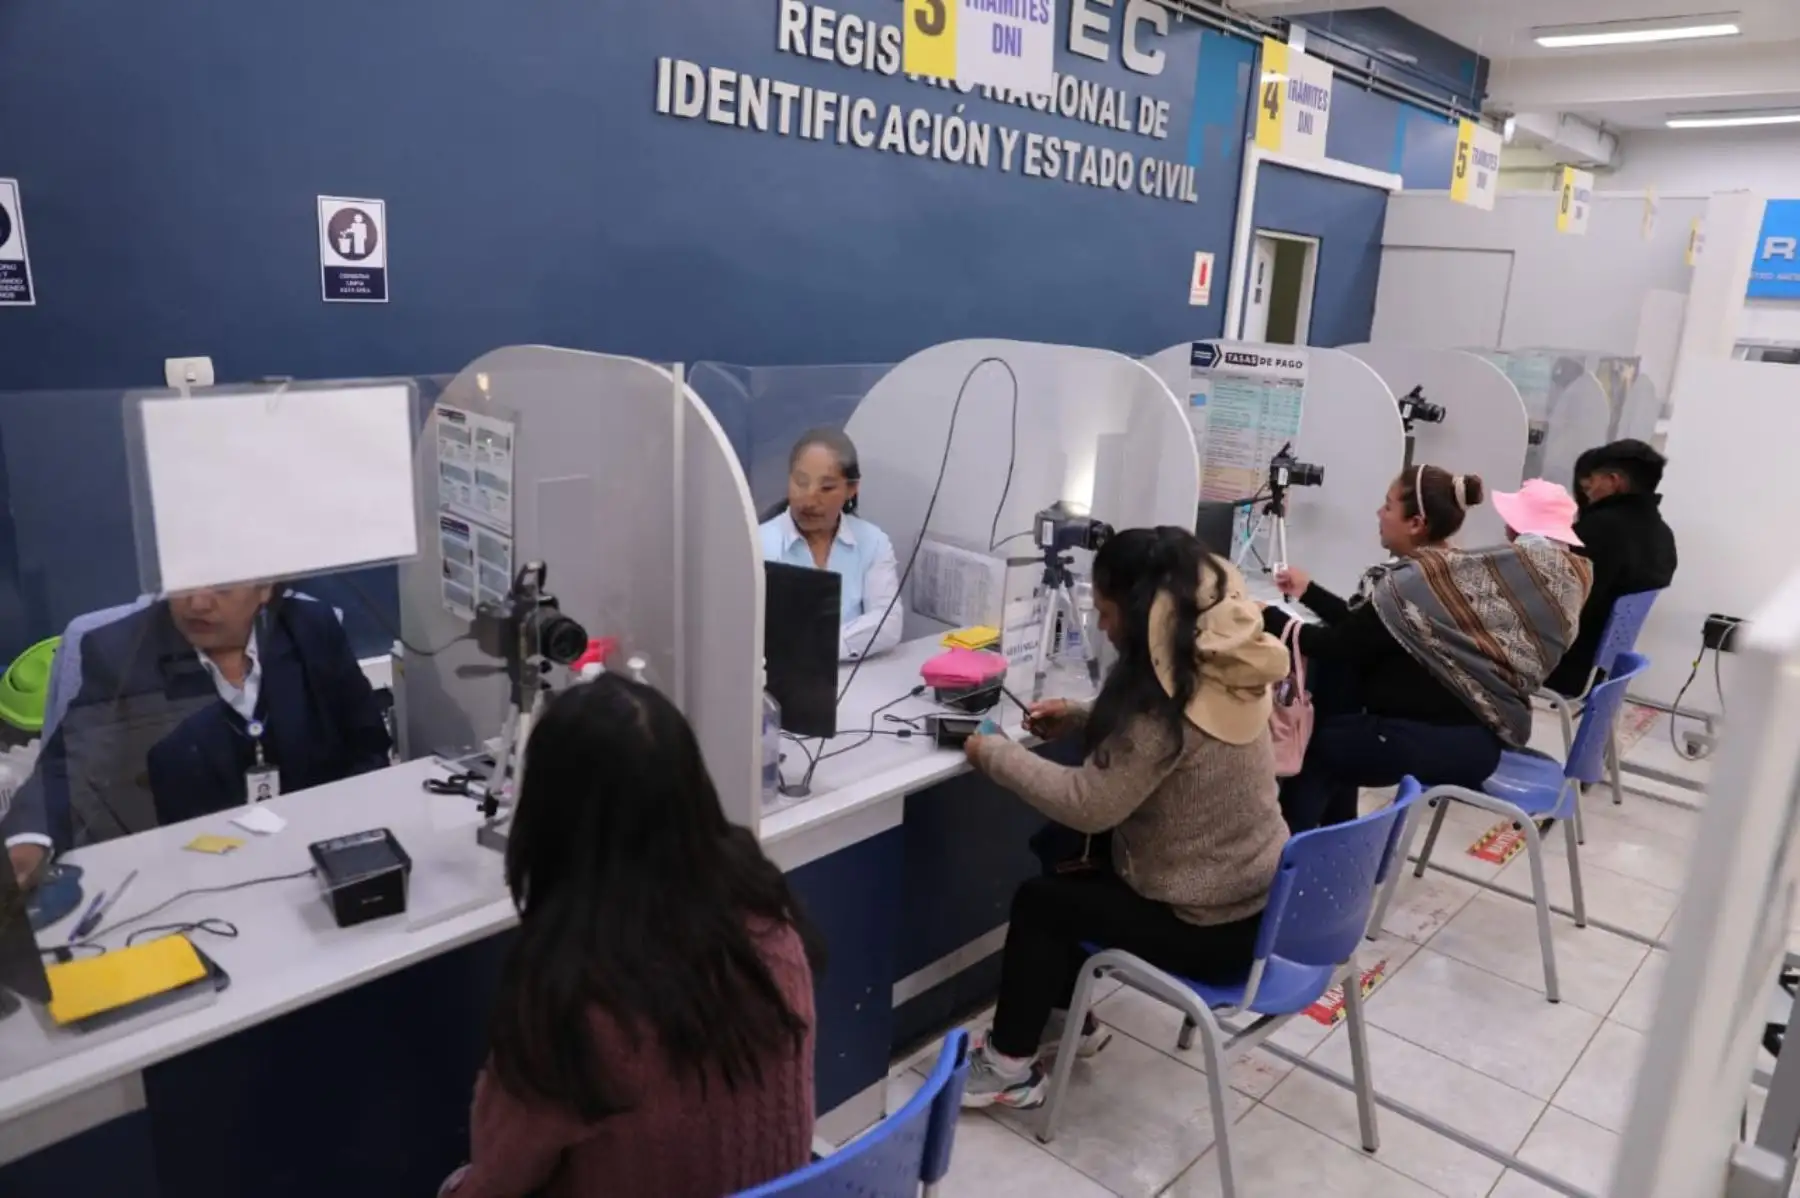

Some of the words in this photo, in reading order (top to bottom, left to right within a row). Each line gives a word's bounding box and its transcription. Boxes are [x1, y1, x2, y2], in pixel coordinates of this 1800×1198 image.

[992, 22, 1022, 58] DNI
[984, 72, 1131, 132] IONAL
[1137, 95, 1170, 139] DE
[1263, 69, 1279, 120] 4
[656, 56, 990, 167] IDENTIFICACIÓN
[997, 126, 1020, 171] Y
[1024, 132, 1134, 191] ESTADO
[1139, 156, 1198, 203] CIVIL
[1456, 140, 1469, 179] 5
[1259, 357, 1272, 367] DE
[1275, 359, 1303, 369] PAGO
